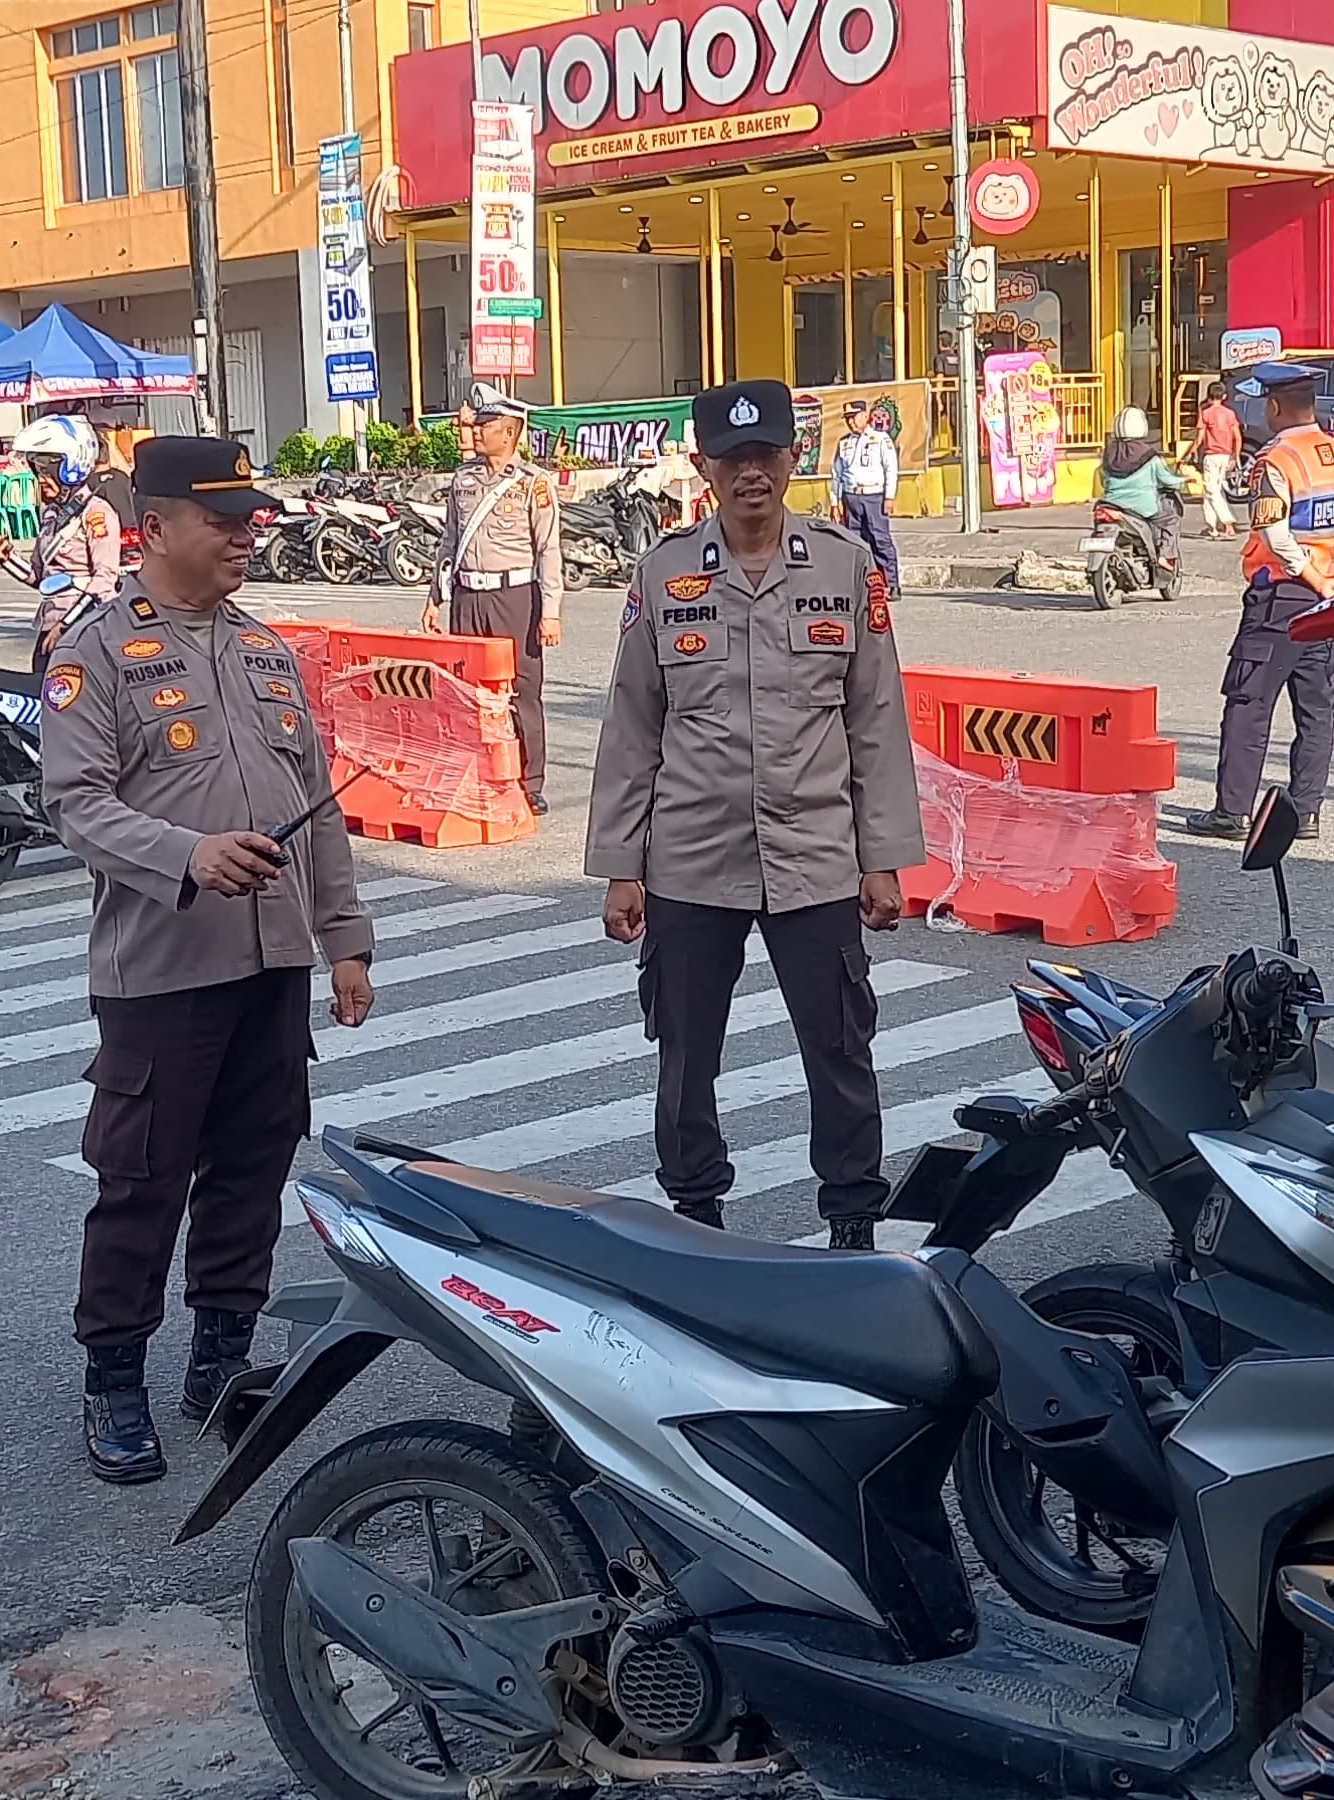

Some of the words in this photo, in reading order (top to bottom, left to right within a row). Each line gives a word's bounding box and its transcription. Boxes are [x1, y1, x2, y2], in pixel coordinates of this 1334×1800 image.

[482, 0, 896, 135] MOMOYO
[1060, 25, 1116, 88] OH!
[1054, 45, 1204, 145] Wonderful!
[569, 145, 588, 159] ICE
[592, 138, 633, 157] CREAM
[636, 134, 649, 153] &
[652, 129, 688, 148] FRUIT
[691, 125, 717, 142] TEA
[719, 122, 733, 140] &
[737, 114, 792, 136] BAKERY
[480, 260, 526, 293] 50%
[575, 421, 633, 465] ONLY
[634, 419, 669, 460] 2K
[663, 605, 717, 625] FEBRI
[795, 596, 850, 612] POLRI
[124, 659, 188, 685] RUSMAN
[244, 655, 292, 674] POLRI
